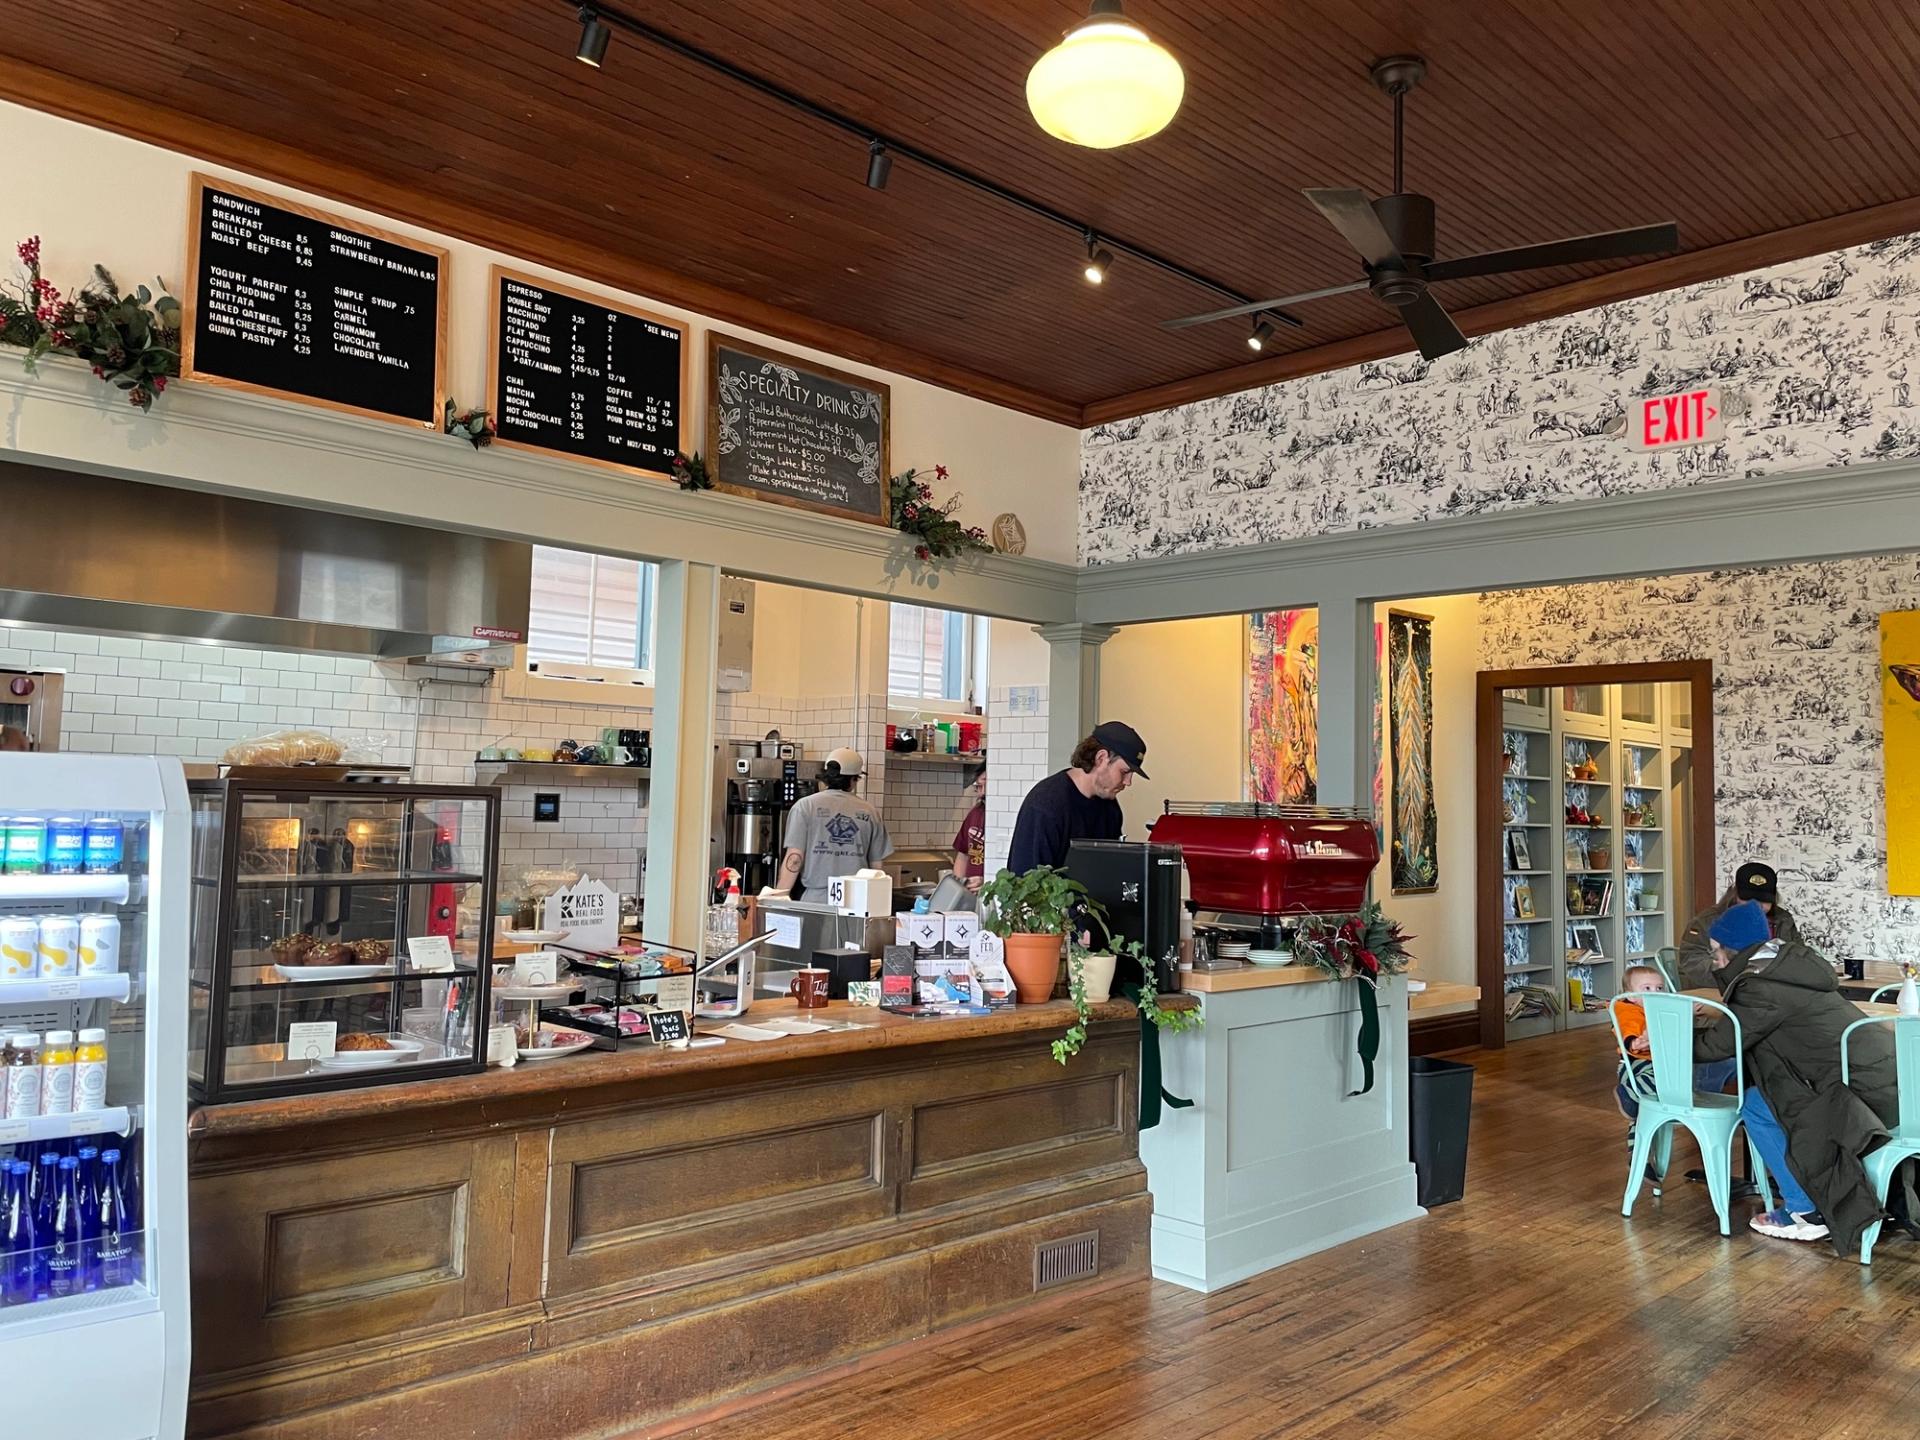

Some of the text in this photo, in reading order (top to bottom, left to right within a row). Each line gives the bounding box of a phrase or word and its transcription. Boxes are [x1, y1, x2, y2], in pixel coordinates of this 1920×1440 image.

[213, 195, 260, 216] SANDWICH
[212, 209, 263, 230] BREAKFAST
[211, 231, 240, 246] ROAST
[247, 242, 269, 255] BEEF
[212, 220, 252, 238] GRILLED
[259, 234, 292, 250] CHEESE
[330, 231, 372, 250] SMOOTHIE
[330, 244, 384, 266] STRAWBERRY
[387, 261, 418, 276] BANANA
[211, 266, 246, 282] YOGURT
[252, 278, 288, 293] PARFAIT
[210, 278, 312, 310] CHIA PUDDING 5.25
[210, 289, 254, 307] FRITTATA
[334, 286, 364, 301] SIMPLE
[372, 296, 396, 309] SYRUP
[209, 300, 239, 314] BAKED
[242, 309, 281, 326] OATMEAL
[334, 299, 367, 316] VANILLA
[508, 296, 532, 309] DOUBLE
[535, 304, 551, 314] SHOT
[508, 284, 542, 300] ESPRESSO
[608, 314, 617, 322] OZ
[661, 329, 678, 340] MENU
[334, 311, 367, 326] CARMEL
[507, 316, 539, 330] CORTADO
[508, 306, 546, 323] MACCHIATO
[209, 324, 236, 337] GUAVA
[242, 332, 275, 346] PASTRY
[268, 327, 288, 338] PUFF
[334, 322, 375, 338] CINNAMON
[507, 326, 524, 336] FLAT
[529, 332, 550, 344] WHITE
[333, 332, 380, 350] CHOCOLATE
[506, 336, 550, 353] CAPPUCCINO
[335, 343, 409, 369] LAVENDER VANILLA
[507, 346, 529, 358] LATTE
[506, 376, 523, 386] CHAI
[506, 395, 529, 407] MOCHA
[507, 386, 535, 399] MATCHA
[606, 396, 618, 404] HOT
[607, 386, 632, 398] COFFEE
[740, 371, 859, 419] SPECIALTY DRINKS
[507, 406, 520, 415] HOT
[523, 410, 562, 425] CHOCOLATE
[606, 405, 623, 414] COLD
[626, 410, 644, 419] BREW
[749, 398, 774, 416] Salted
[607, 415, 622, 424] POUR
[749, 412, 786, 428] Peppermint
[1645, 392, 1708, 446] EXIT
[749, 427, 786, 439] Peppermint
[789, 434, 800, 444] Hot
[749, 439, 775, 449] Winter
[749, 449, 775, 466] Chaga
[830, 882, 842, 901] 45
[576, 894, 603, 908] KATE'S
